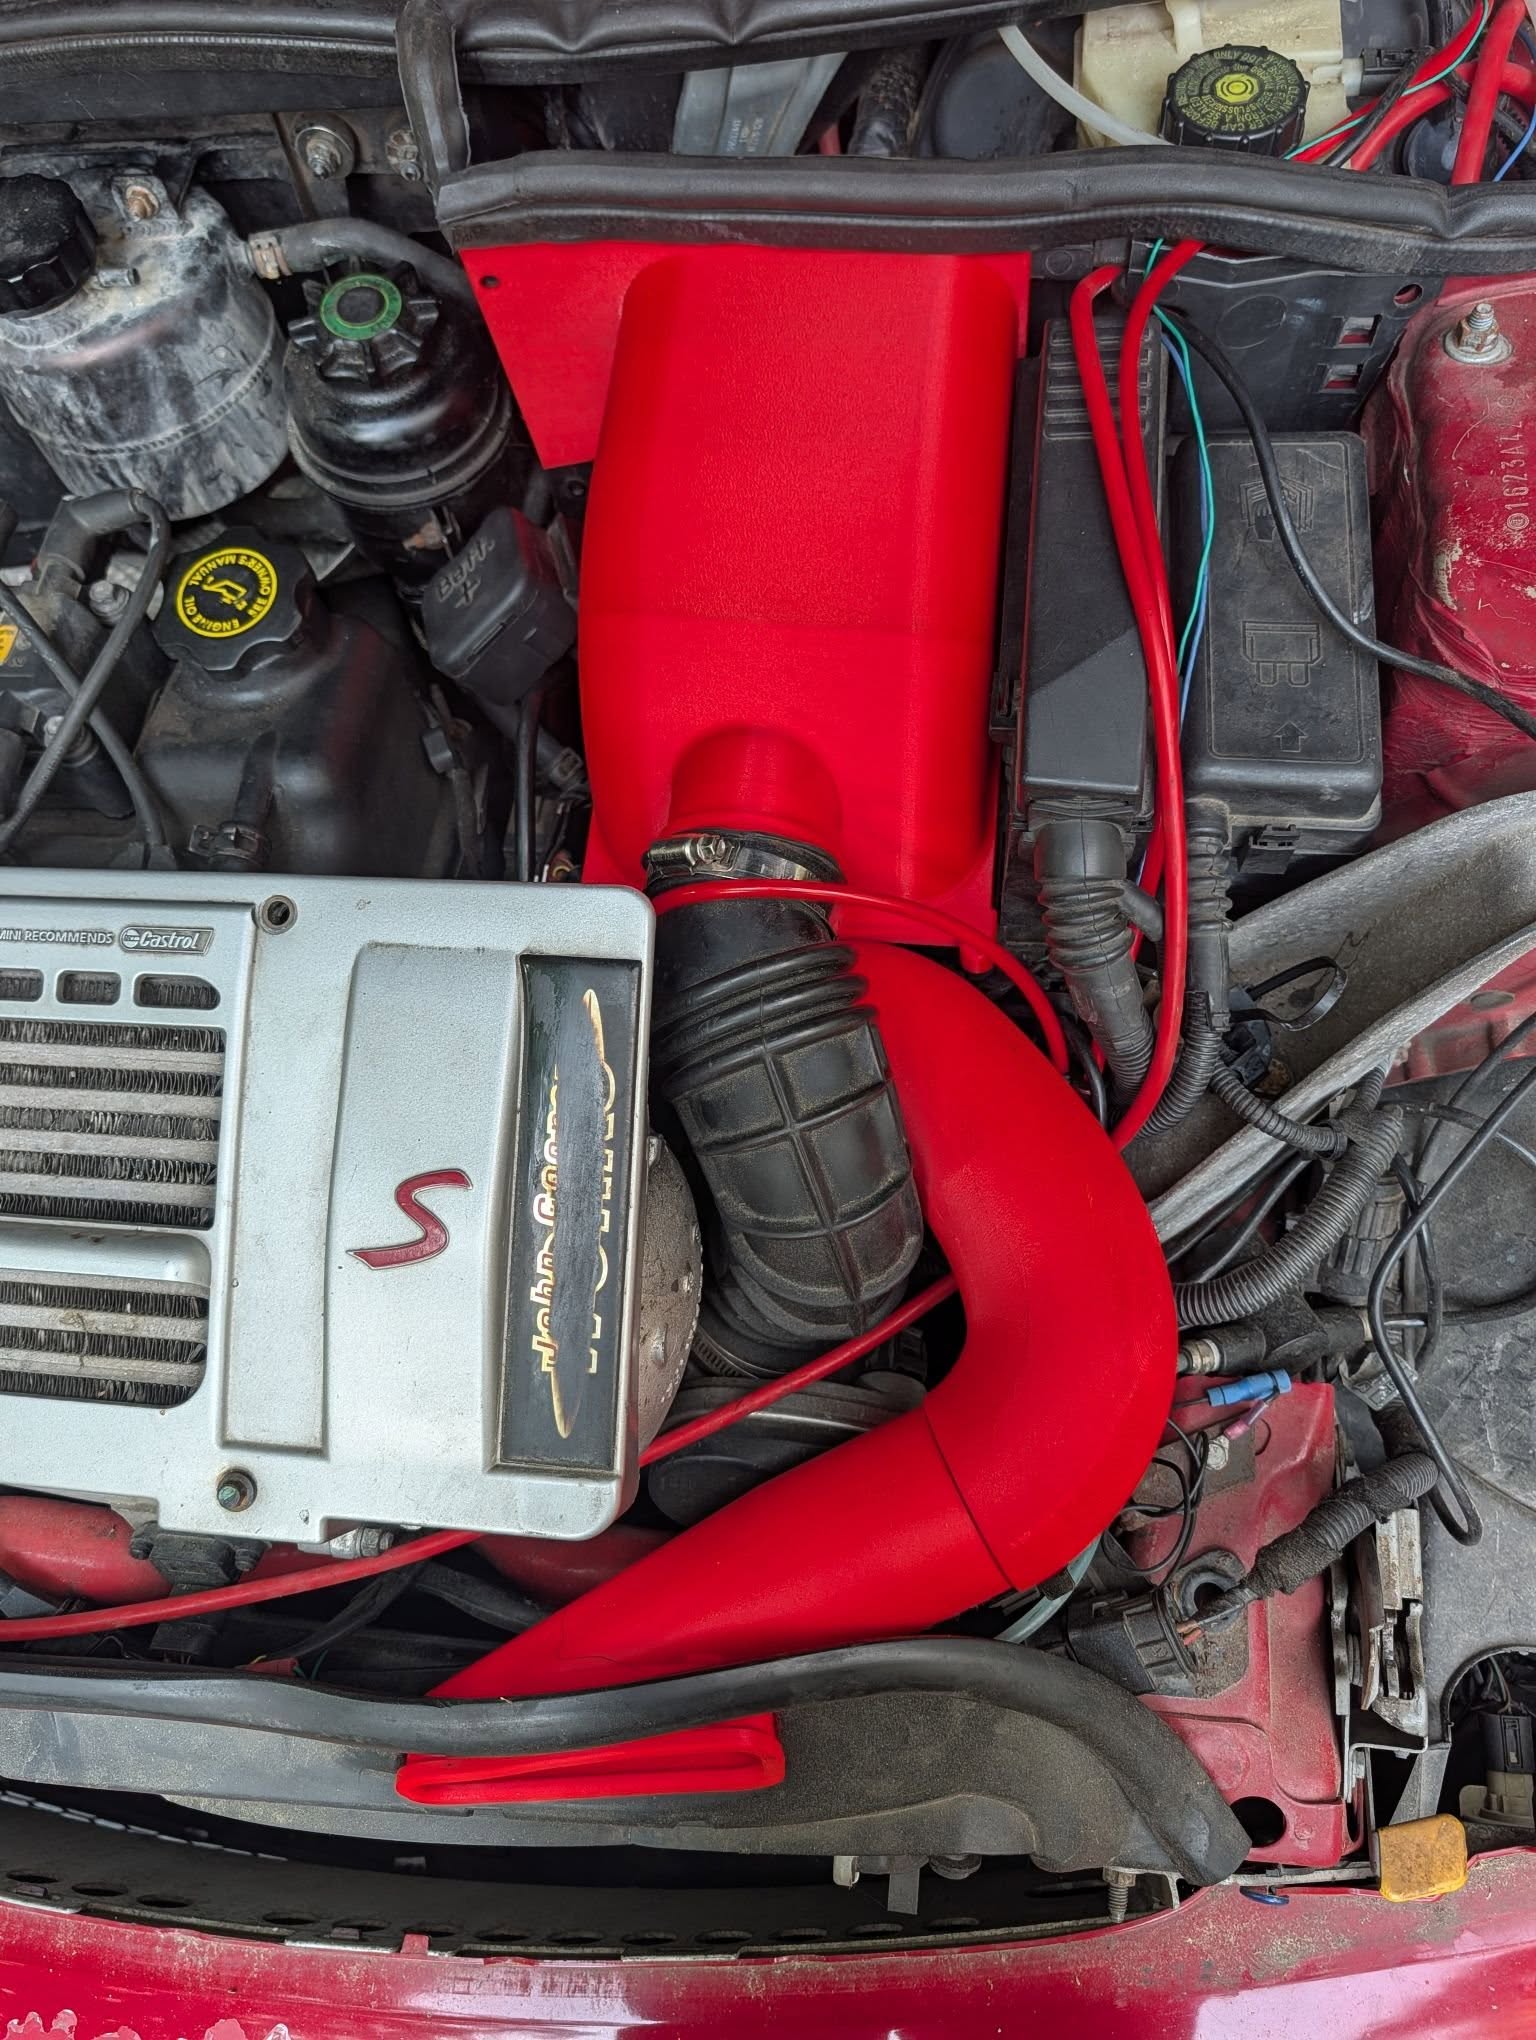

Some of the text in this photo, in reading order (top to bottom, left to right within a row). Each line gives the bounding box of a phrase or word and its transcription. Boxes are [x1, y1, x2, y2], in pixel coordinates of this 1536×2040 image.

[1213, 50, 1239, 60] ONLY
[1240, 52, 1264, 64] DOT
[1181, 105, 1219, 128] BEFORE
[1221, 122, 1246, 131] CAP
[1248, 110, 1285, 128] FILLER
[188, 555, 271, 618] SEE OWNER'S MANUAL
[184, 595, 240, 631] ENGINE OIL
[24, 929, 113, 944] RECOMMENDS
[139, 930, 200, 949] Castrol
[346, 1168, 473, 1270] S
